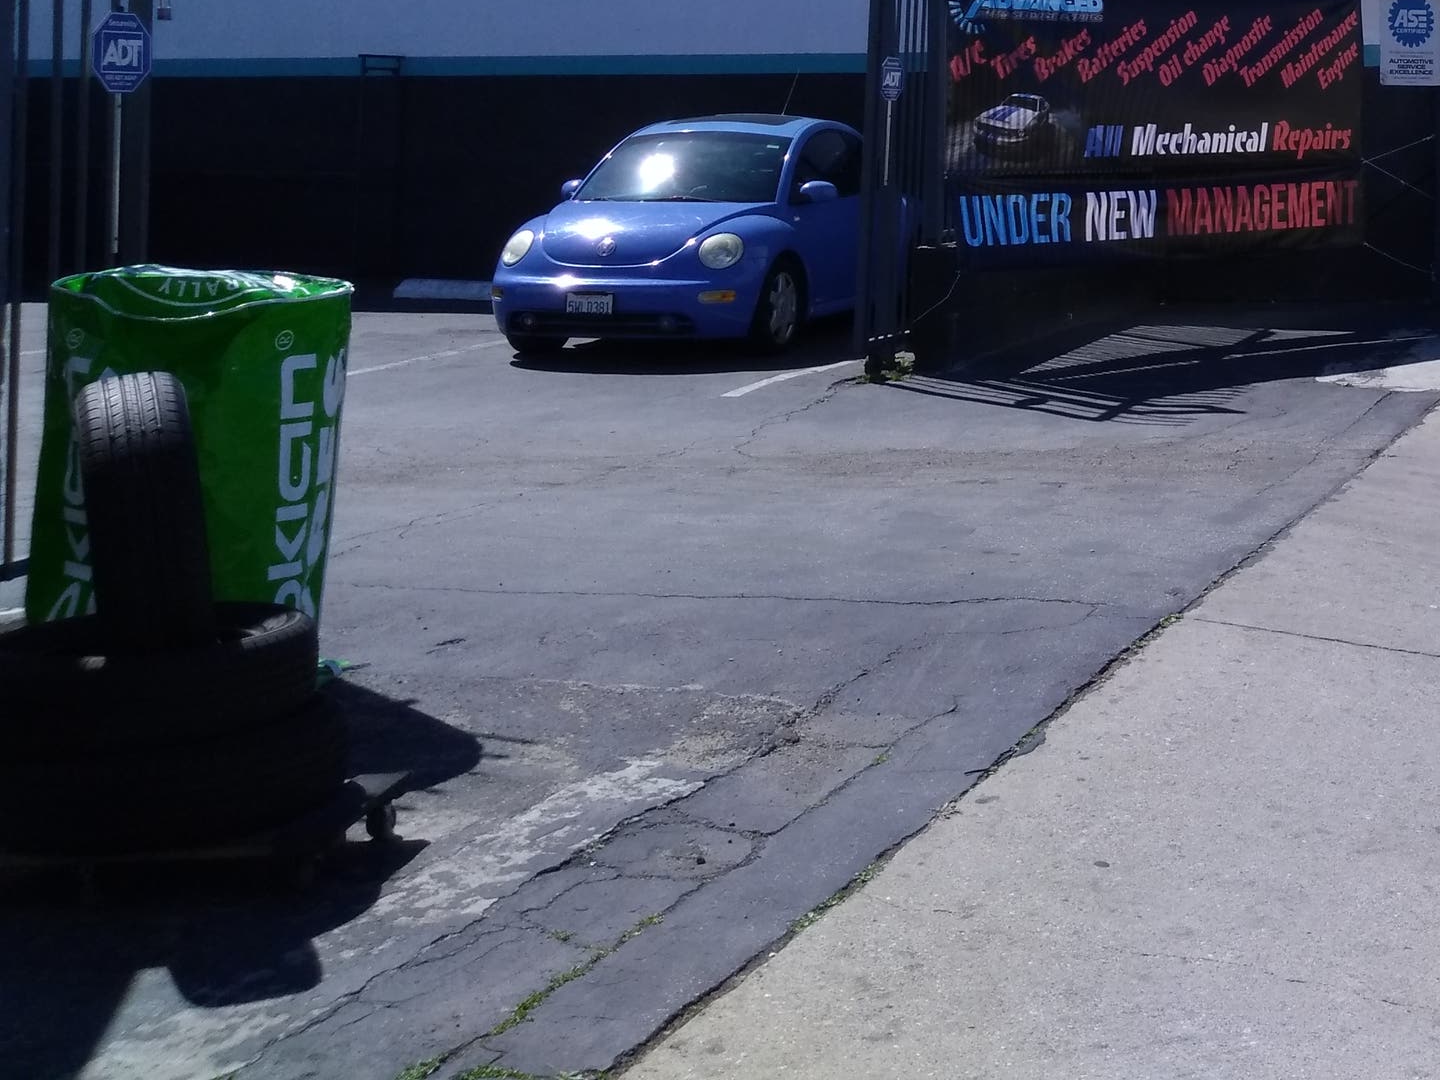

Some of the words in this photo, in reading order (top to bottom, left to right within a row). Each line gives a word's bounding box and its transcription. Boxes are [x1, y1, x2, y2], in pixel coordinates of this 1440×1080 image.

[1117, 10, 1198, 86] Suspension
[1239, 8, 1324, 88] Transmission
[1393, 9, 1427, 28] ASE
[103, 38, 143, 67] ADT
[991, 35, 1037, 80] Tires
[1034, 28, 1092, 83] Brakes
[1078, 19, 1148, 84] Batteries
[1159, 54, 1183, 87] Oil
[1183, 15, 1231, 66] change
[1202, 16, 1273, 87] Diagnostic
[1280, 10, 1358, 88] Maintenance
[1317, 41, 1359, 90] Engine
[883, 71, 902, 88] ADT
[1083, 124, 1123, 158] All
[1131, 122, 1268, 156] Mechanical
[1272, 120, 1352, 160] Repairs
[959, 192, 1073, 248] UNDER
[1084, 189, 1157, 242] NEW
[1165, 180, 1359, 237] MANAGEMENT
